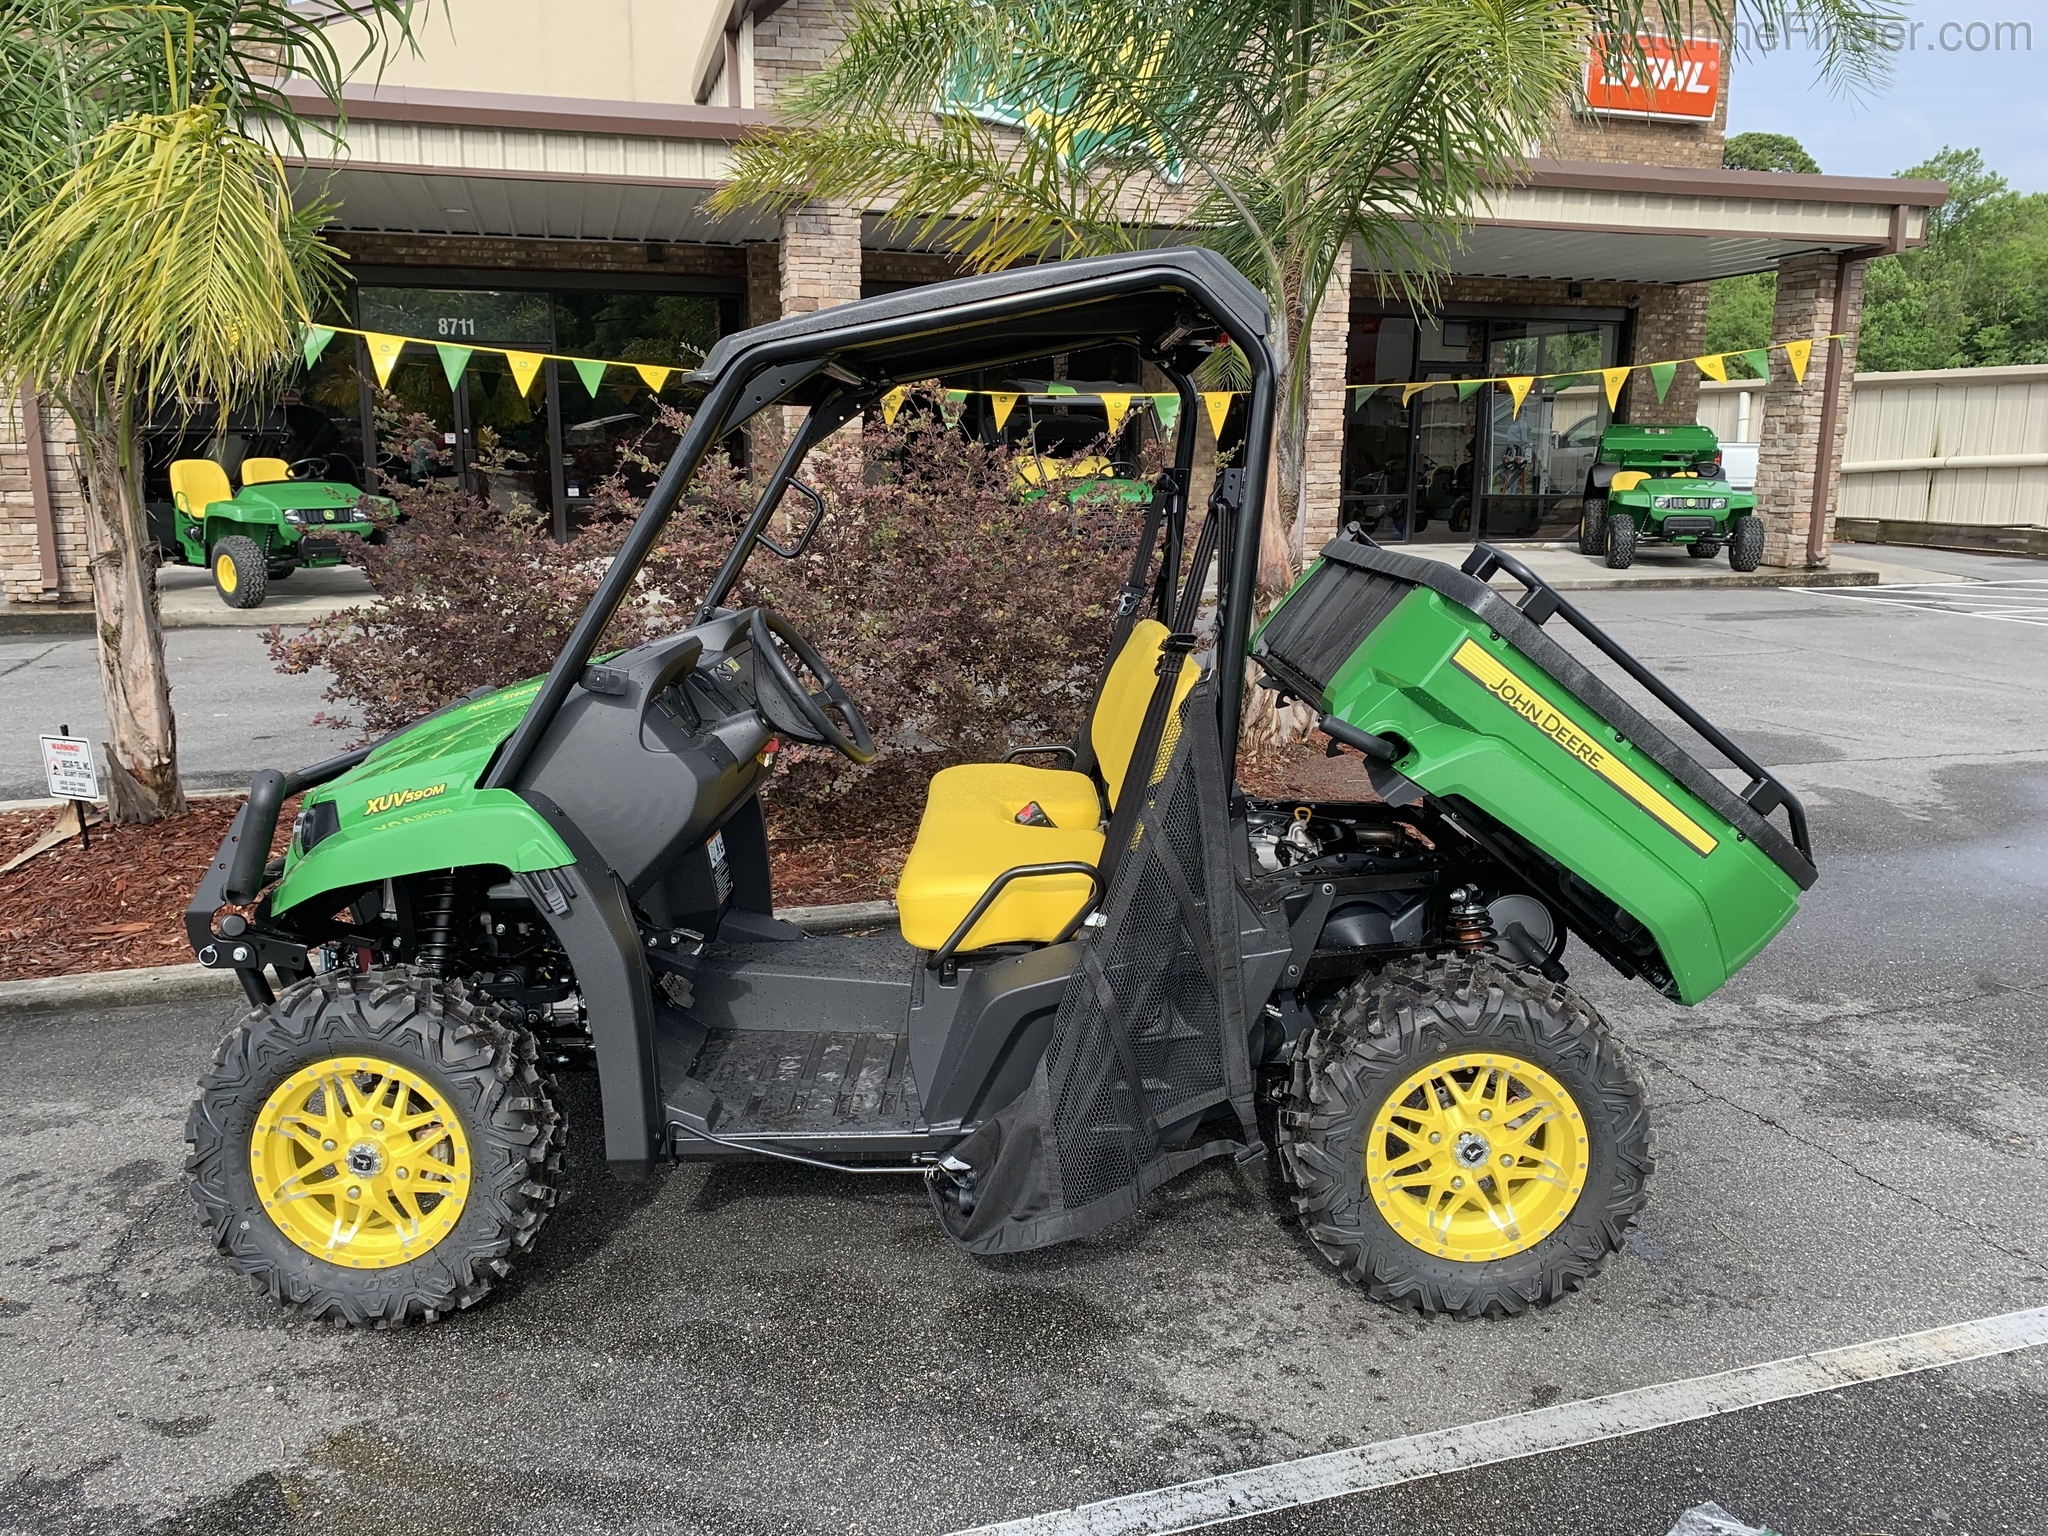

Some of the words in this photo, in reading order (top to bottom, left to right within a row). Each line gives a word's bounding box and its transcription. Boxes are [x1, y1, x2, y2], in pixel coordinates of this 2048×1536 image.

[438, 317, 475, 336] 8711
[466, 698, 499, 713] Power
[1489, 677, 1544, 721] JOHN
[1541, 712, 1605, 769] DEERE
[362, 782, 447, 817] XUV590M
